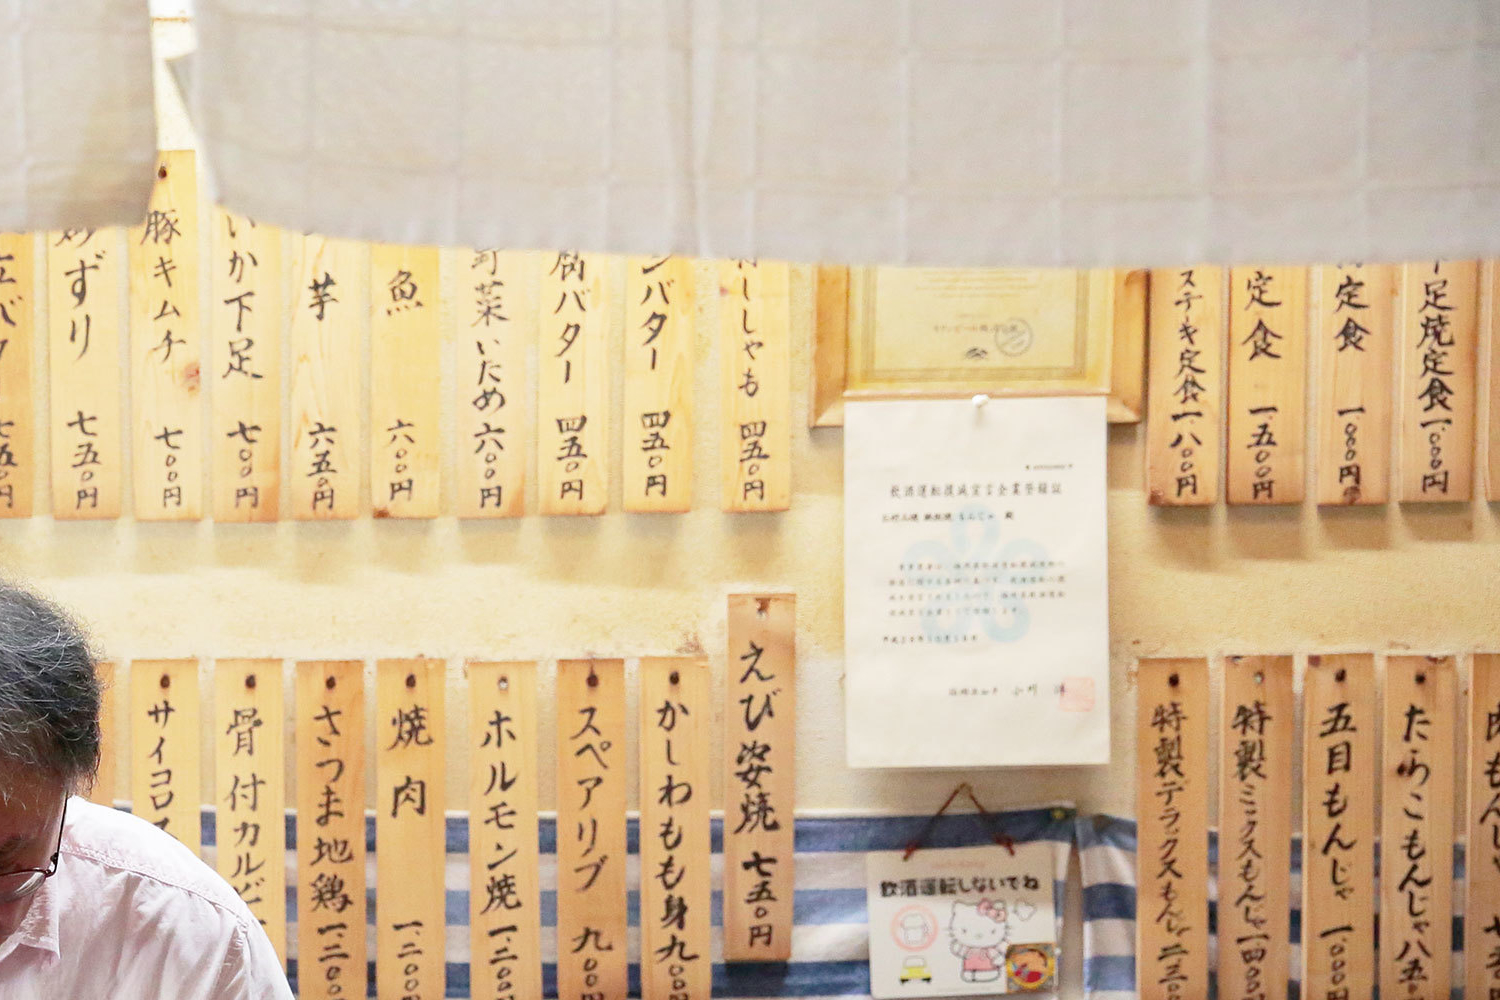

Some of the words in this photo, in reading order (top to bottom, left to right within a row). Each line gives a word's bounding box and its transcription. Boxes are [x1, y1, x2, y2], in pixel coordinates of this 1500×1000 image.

[140, 210, 186, 364] 豚キムチ
[738, 257, 764, 397] ししゃも
[1242, 270, 1283, 361] 定食
[1332, 263, 1371, 352] 定食
[309, 705, 354, 914] さつま地鶏
[386, 704, 434, 818] 焼肉
[479, 710, 522, 915] ホルモン焼
[570, 706, 612, 893] スペアリブ
[655, 700, 694, 929] かしわもも身
[734, 641, 782, 835] えび姿焼
[1319, 702, 1358, 900] 五目もんじゃ
[1397, 704, 1433, 933] たらこもんじゃ
